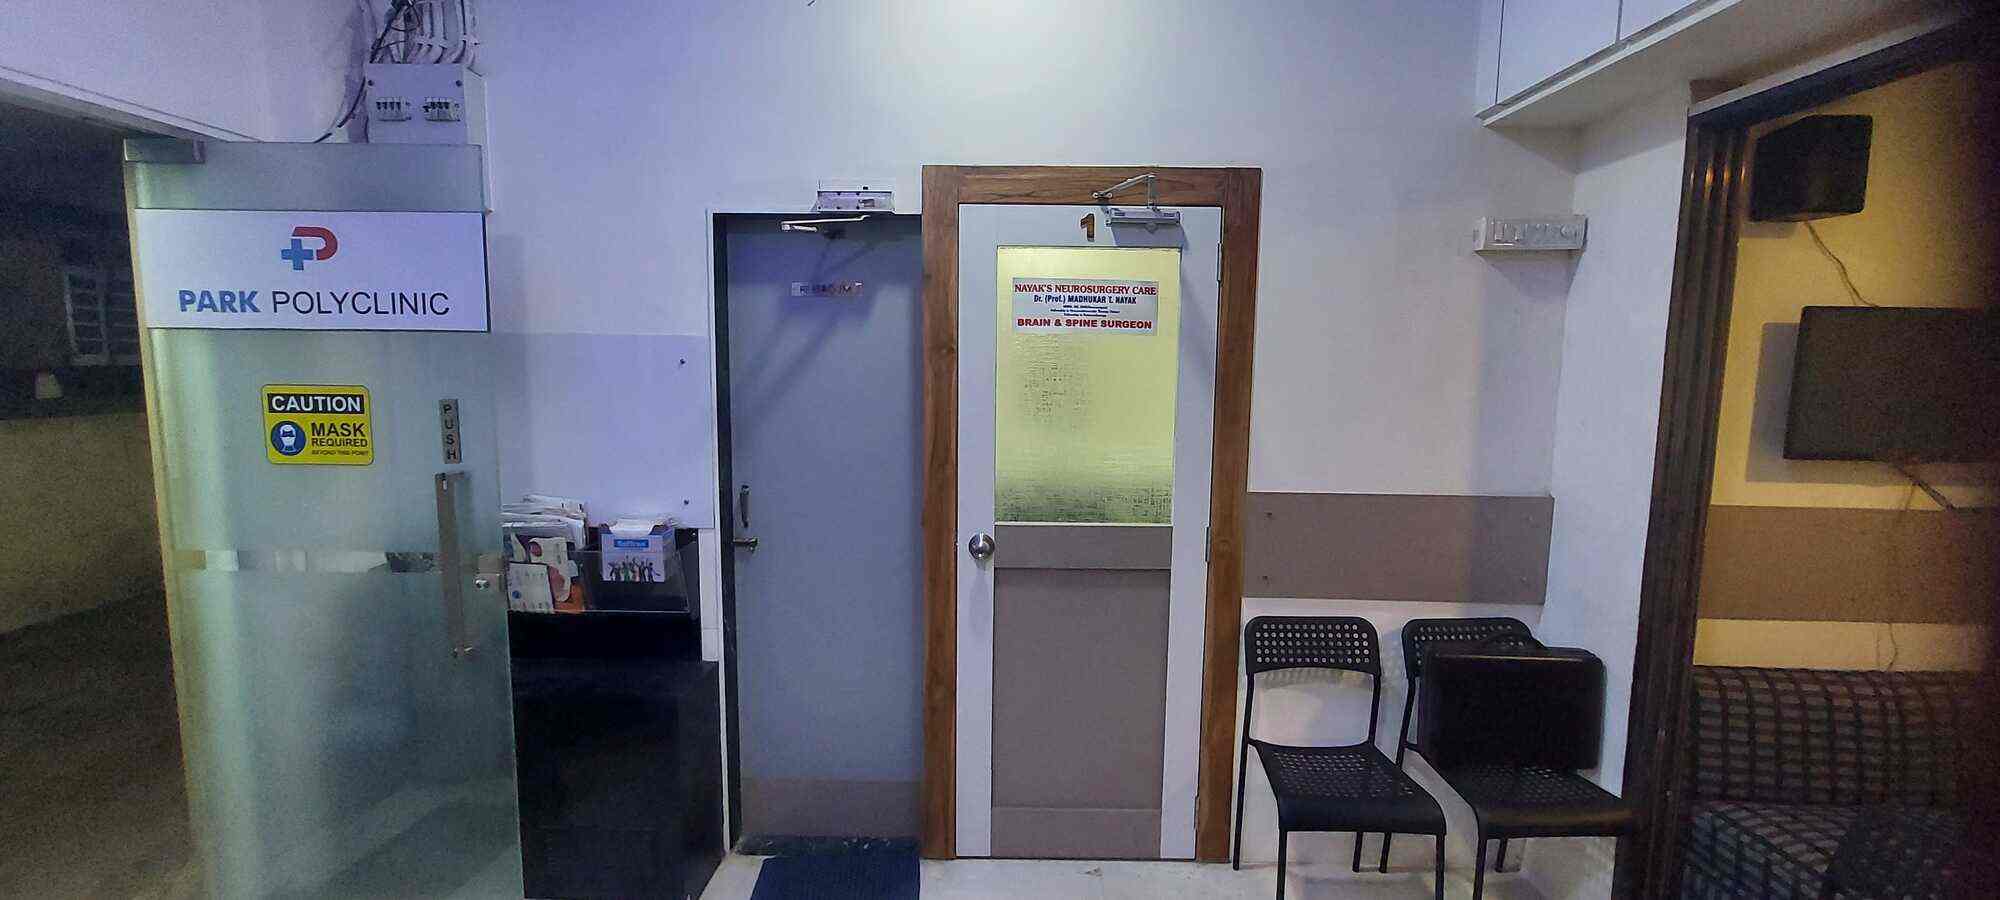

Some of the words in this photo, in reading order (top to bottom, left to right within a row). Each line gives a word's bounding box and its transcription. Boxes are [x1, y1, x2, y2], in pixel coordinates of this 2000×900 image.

[1080, 213, 1095, 242] 1
[1014, 284, 1052, 293] NAYAK'S
[1055, 284, 1129, 295] NEUROSURGERY
[1132, 286, 1157, 296] CARE
[178, 290, 259, 313] PARK
[272, 291, 450, 315] POLYCLINIC
[1033, 294, 1043, 303] Dr.
[1045, 294, 1066, 304] (Prof.)
[1067, 295, 1106, 304] MADHUKAR
[1115, 296, 1137, 305] NAYAK
[1017, 318, 1051, 327] BRAIN
[1054, 319, 1061, 327] &
[1065, 319, 1098, 328] SPINE
[1100, 319, 1152, 329] SURGEON
[271, 396, 360, 412] CAUTION
[311, 422, 366, 437] MASK
[443, 404, 457, 460] PUSH
[311, 438, 368, 447] REQUIRED
